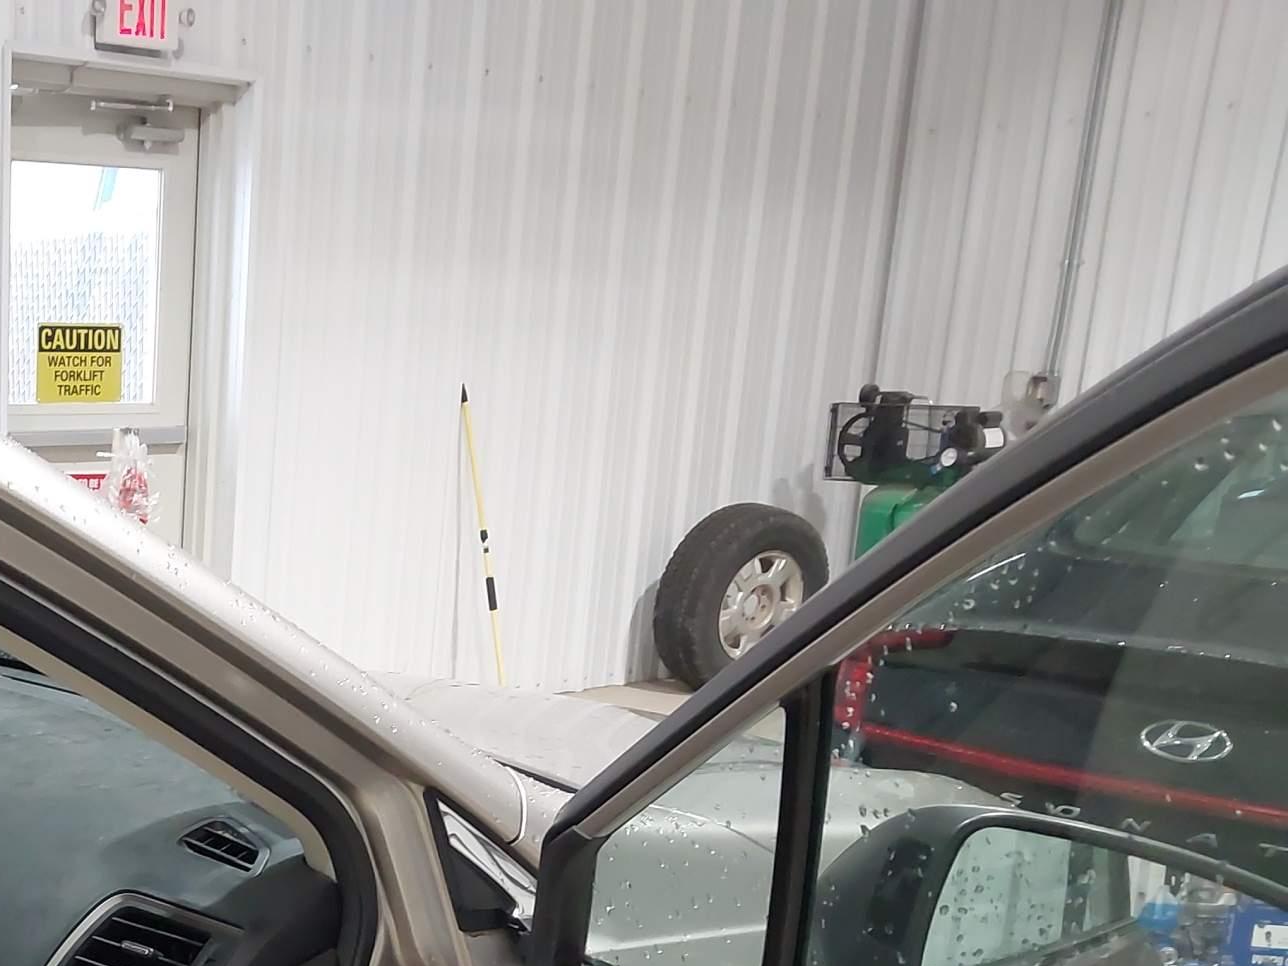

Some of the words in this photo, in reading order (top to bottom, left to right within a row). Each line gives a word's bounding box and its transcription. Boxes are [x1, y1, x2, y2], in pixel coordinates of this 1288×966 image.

[40, 327, 119, 350] CAUTION
[47, 355, 88, 368] WATCH
[90, 355, 112, 368] FOR
[53, 369, 105, 382] FORKLIFT
[56, 383, 102, 396] TRAFFIC
